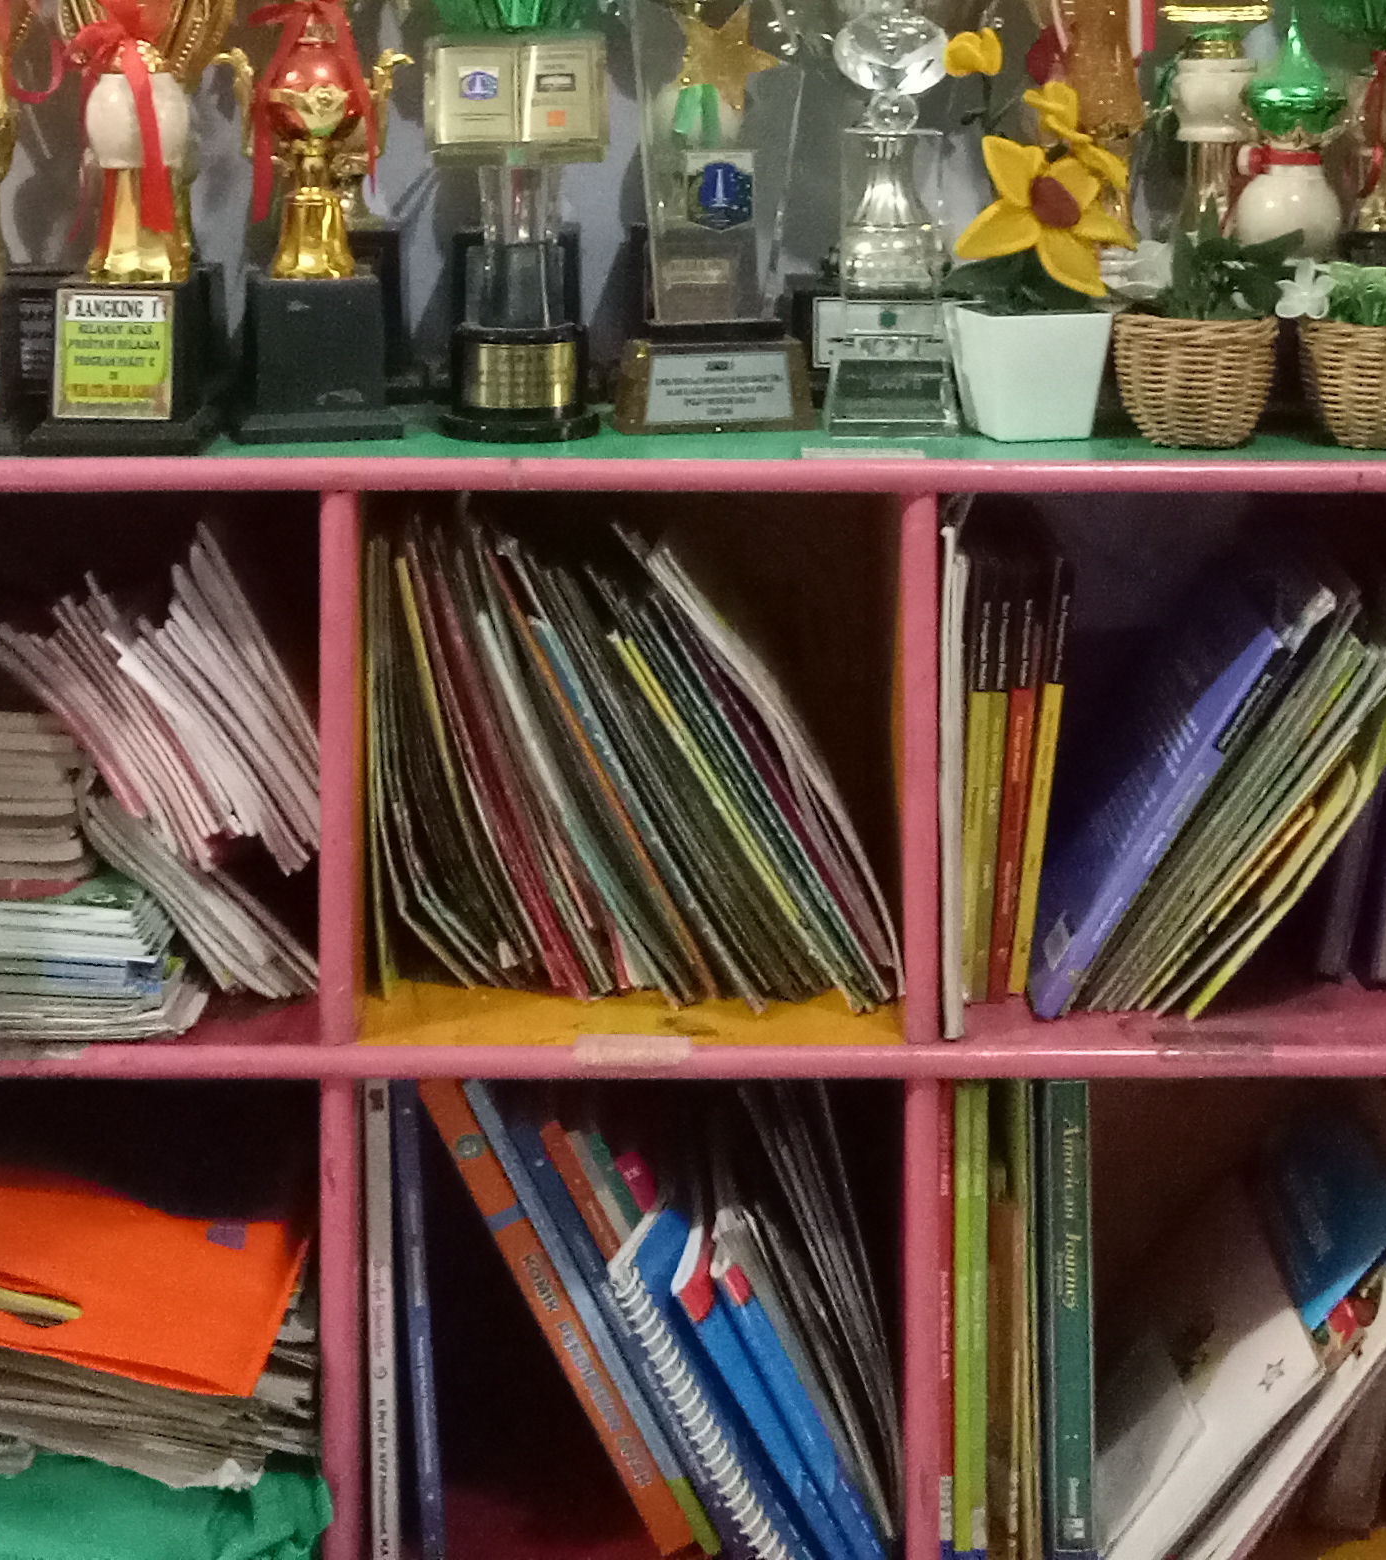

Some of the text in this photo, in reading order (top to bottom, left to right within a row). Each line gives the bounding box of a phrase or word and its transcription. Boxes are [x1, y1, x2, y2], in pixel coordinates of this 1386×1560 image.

[75, 299, 144, 318] RANGKING
[1061, 1117, 1083, 1310] American Journey
